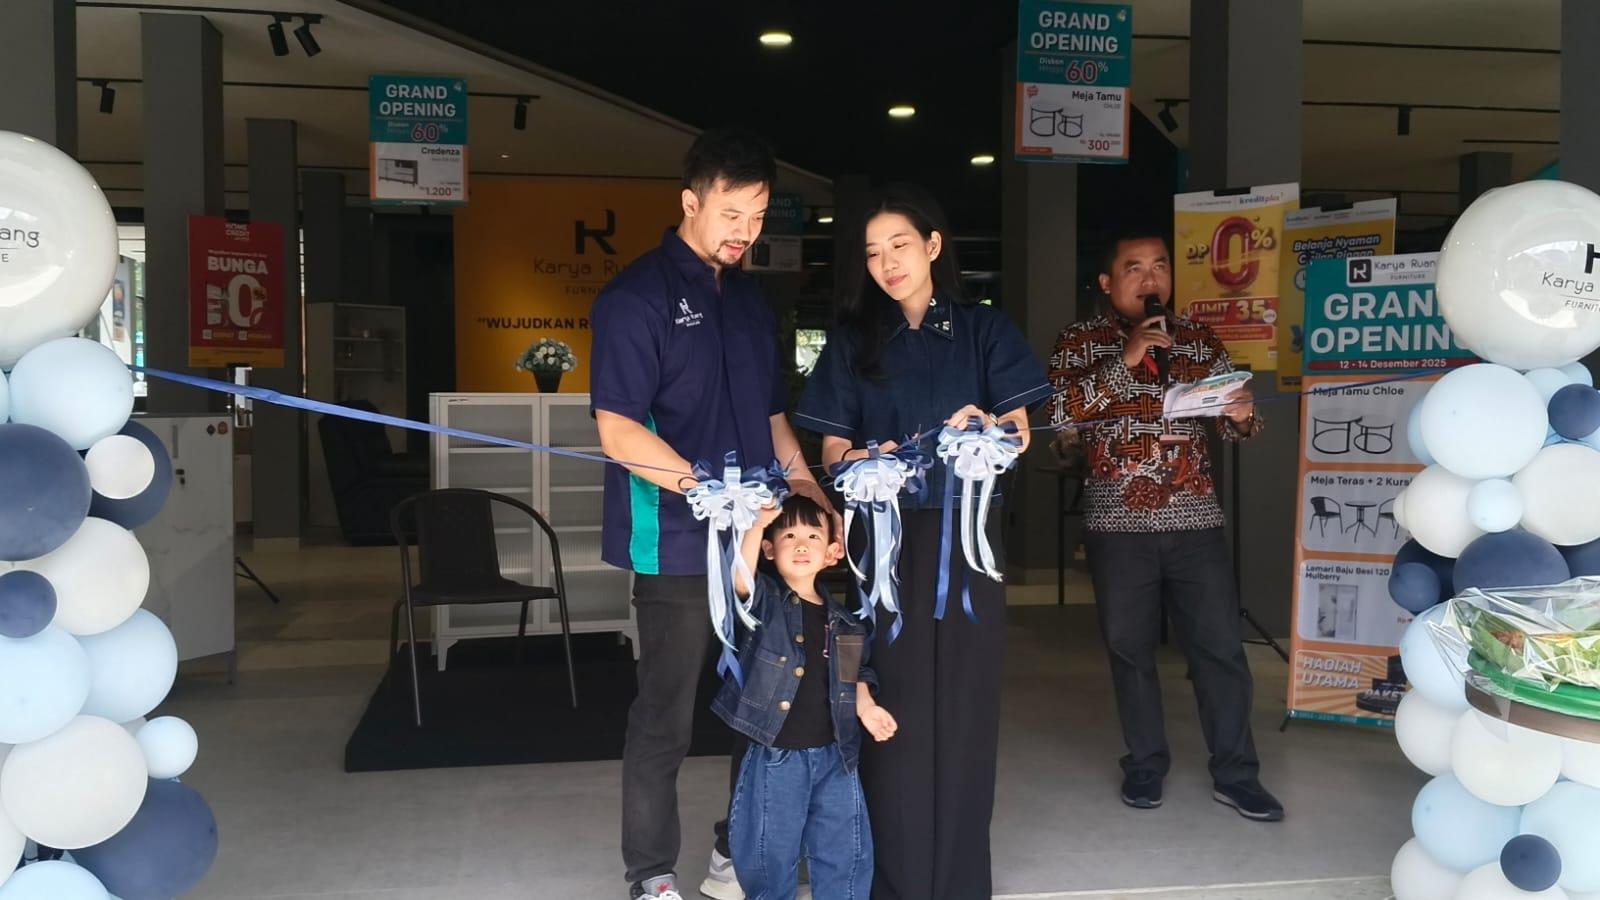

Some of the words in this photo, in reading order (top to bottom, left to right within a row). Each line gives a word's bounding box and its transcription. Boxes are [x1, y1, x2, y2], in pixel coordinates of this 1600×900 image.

[1038, 11, 1110, 31] GRAND
[1030, 32, 1119, 54] OPENING
[1065, 59, 1109, 84] 60%
[385, 84, 448, 99] GRAND
[1072, 90, 1094, 102] Meja
[1096, 92, 1122, 102] Tamu
[379, 101, 456, 117] OPENING
[421, 147, 460, 156] Credenza
[1088, 140, 1110, 151] 300
[768, 198, 792, 207] AND
[0, 228, 40, 248] ang
[1294, 239, 1334, 252] Belanja
[1336, 235, 1380, 250] Nyaman
[207, 256, 269, 274] BUNGA
[533, 257, 592, 278] Karya
[604, 259, 626, 276] Ru
[1374, 261, 1405, 272] Karya
[1411, 258, 1437, 269] Ruan
[1390, 274, 1425, 282] FURNITURE
[1542, 271, 1594, 295] Karya
[565, 286, 601, 296] FURNI
[1194, 302, 1231, 314] LIMIT
[1236, 299, 1265, 321] 35
[1564, 300, 1600, 313] FURNIT
[1339, 360, 1349, 369] 12
[1358, 360, 1368, 369] 14
[1370, 359, 1419, 369] Desember
[1421, 358, 1447, 368] 2025
[1341, 386, 1370, 396] Tamu
[1372, 386, 1405, 396] Chloe
[1310, 476, 1335, 488] Meja
[1337, 477, 1365, 487] Teras
[1376, 477, 1383, 486] 2
[1305, 572, 1341, 582] Mulberry
[1306, 564, 1333, 574] Lemari
[1335, 566, 1353, 578] Baju
[1355, 567, 1373, 576] Besi
[1375, 568, 1390, 577] 120
[1303, 656, 1361, 673] HADIAH
[1302, 673, 1360, 689] UTAMA
